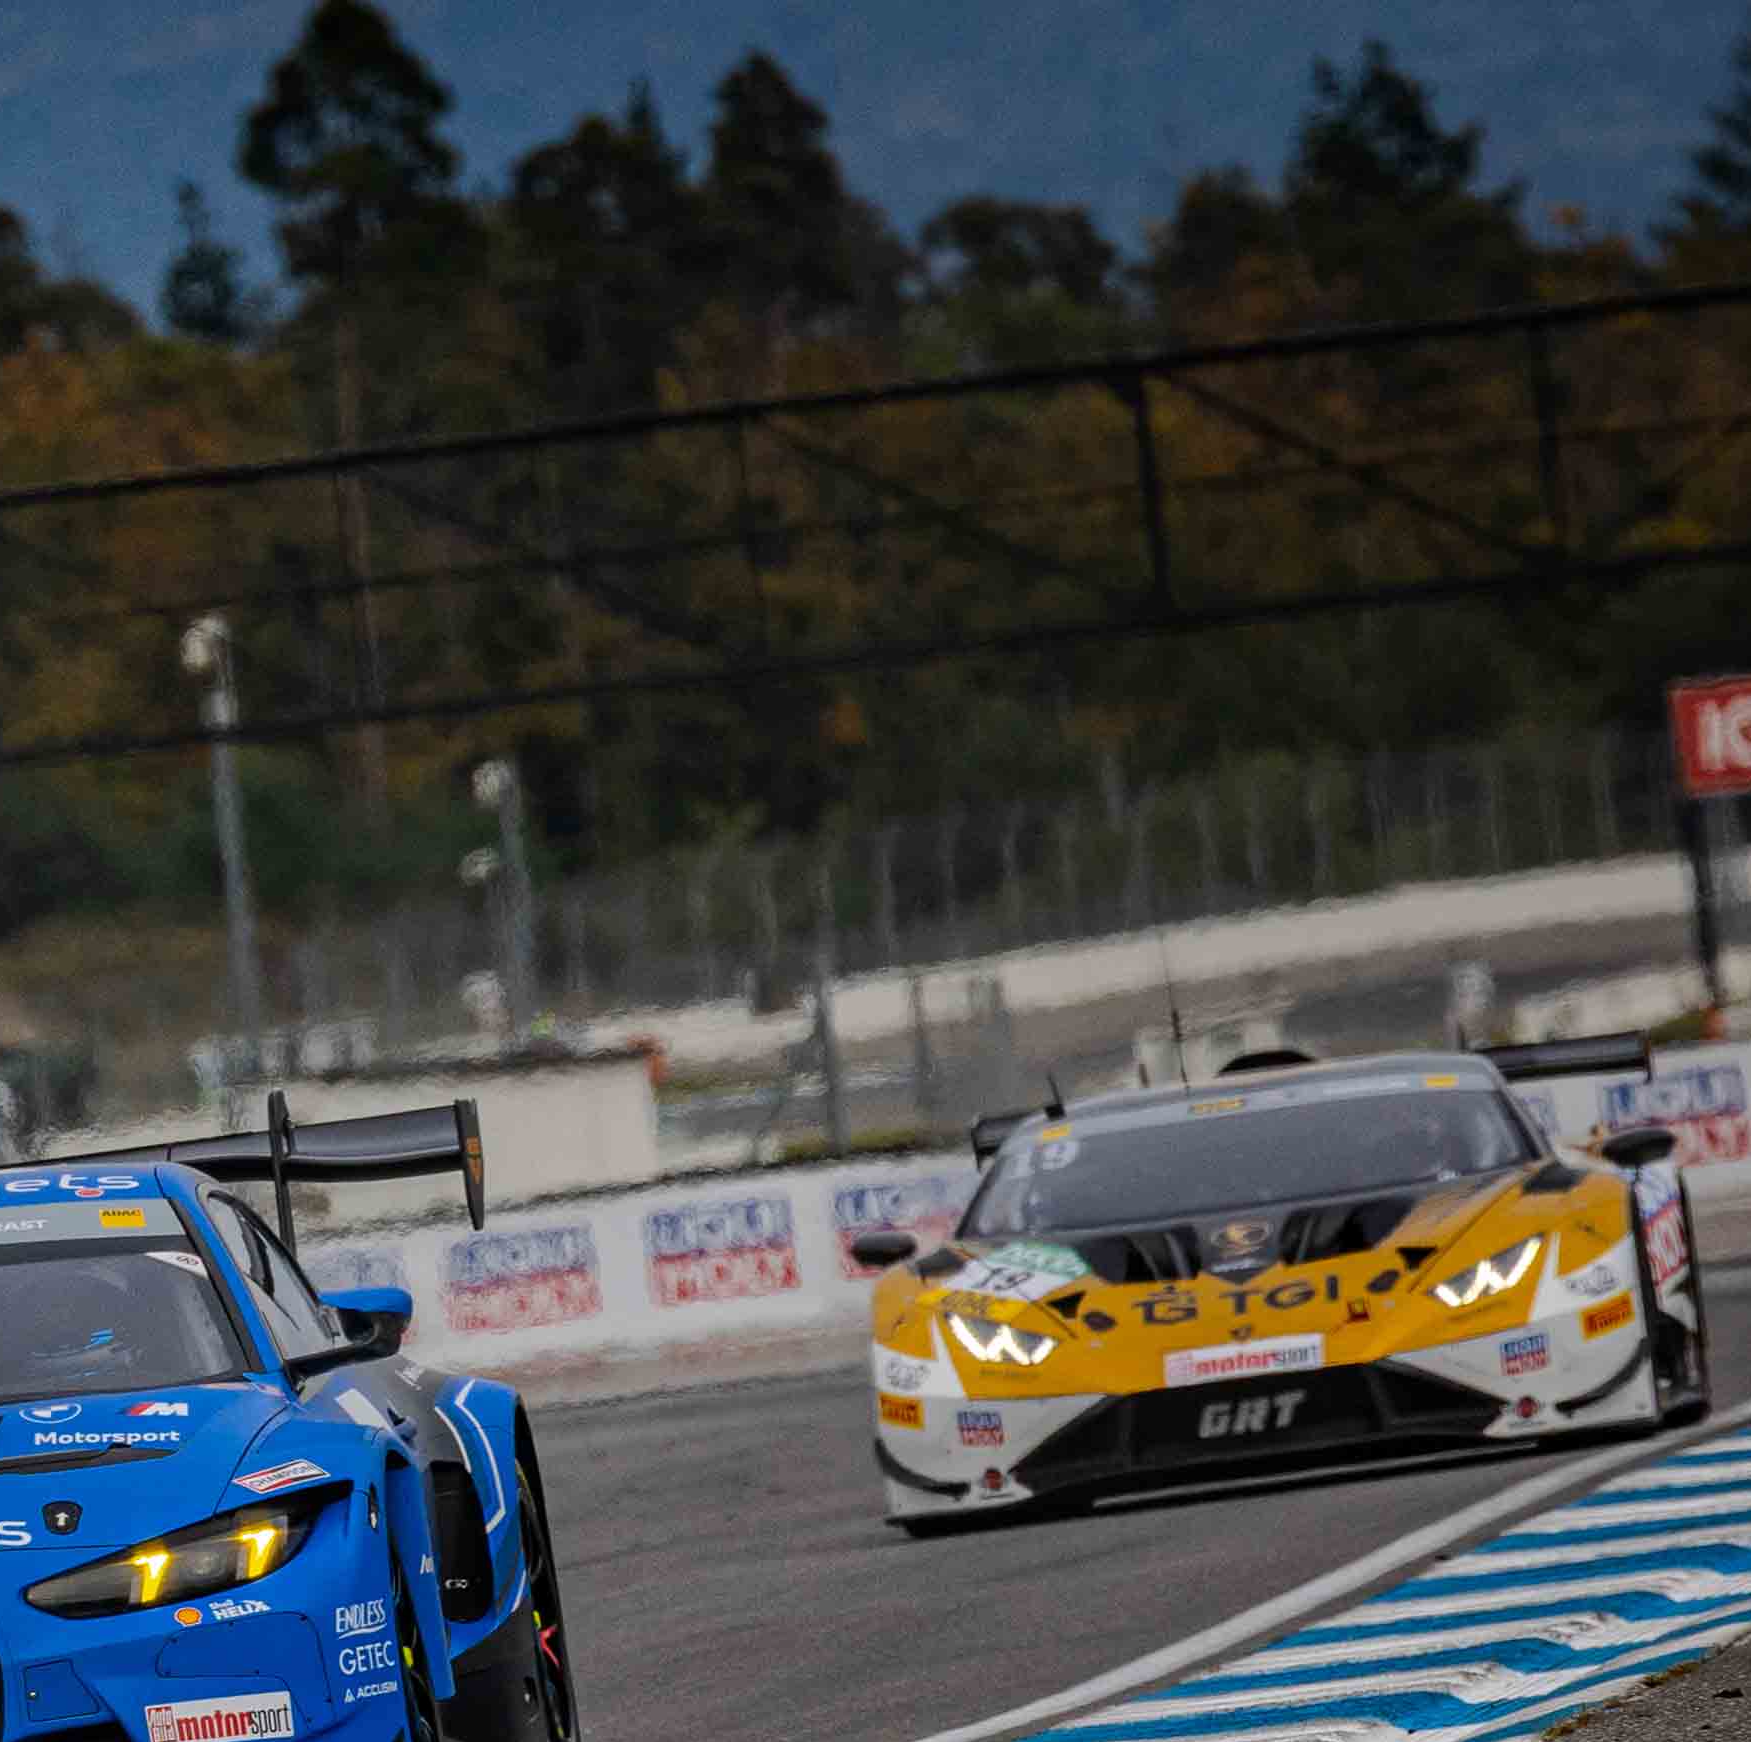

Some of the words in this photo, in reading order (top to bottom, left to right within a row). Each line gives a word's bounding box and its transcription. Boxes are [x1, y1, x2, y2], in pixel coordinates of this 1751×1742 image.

[1199, 1389, 1306, 1439] GRT
[34, 1430, 180, 1446] Motorsport
[211, 1601, 272, 1620] HELIX
[334, 1599, 387, 1633] ENDLESS
[338, 1640, 396, 1675] GETEC
[177, 1703, 291, 1741] motorsport
